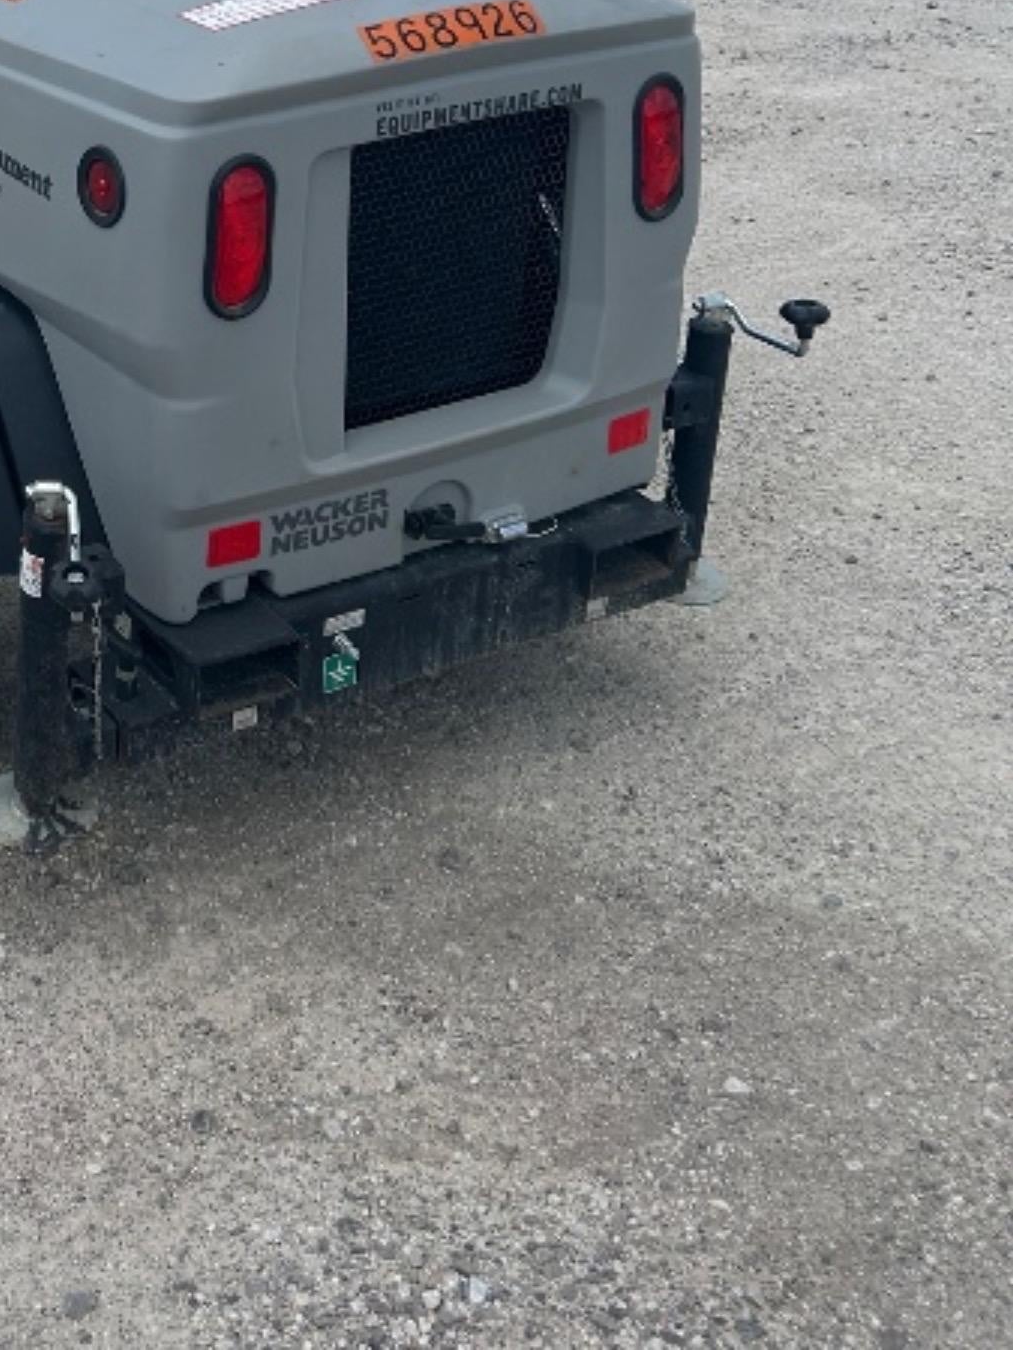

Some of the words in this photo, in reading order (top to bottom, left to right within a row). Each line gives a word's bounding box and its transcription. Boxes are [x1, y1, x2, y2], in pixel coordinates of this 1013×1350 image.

[365, 0, 537, 59] 568926
[376, 83, 583, 136] EQUIPMENTSHARE.COM
[269, 488, 389, 533] WACKER
[270, 510, 389, 557] NEUSON
